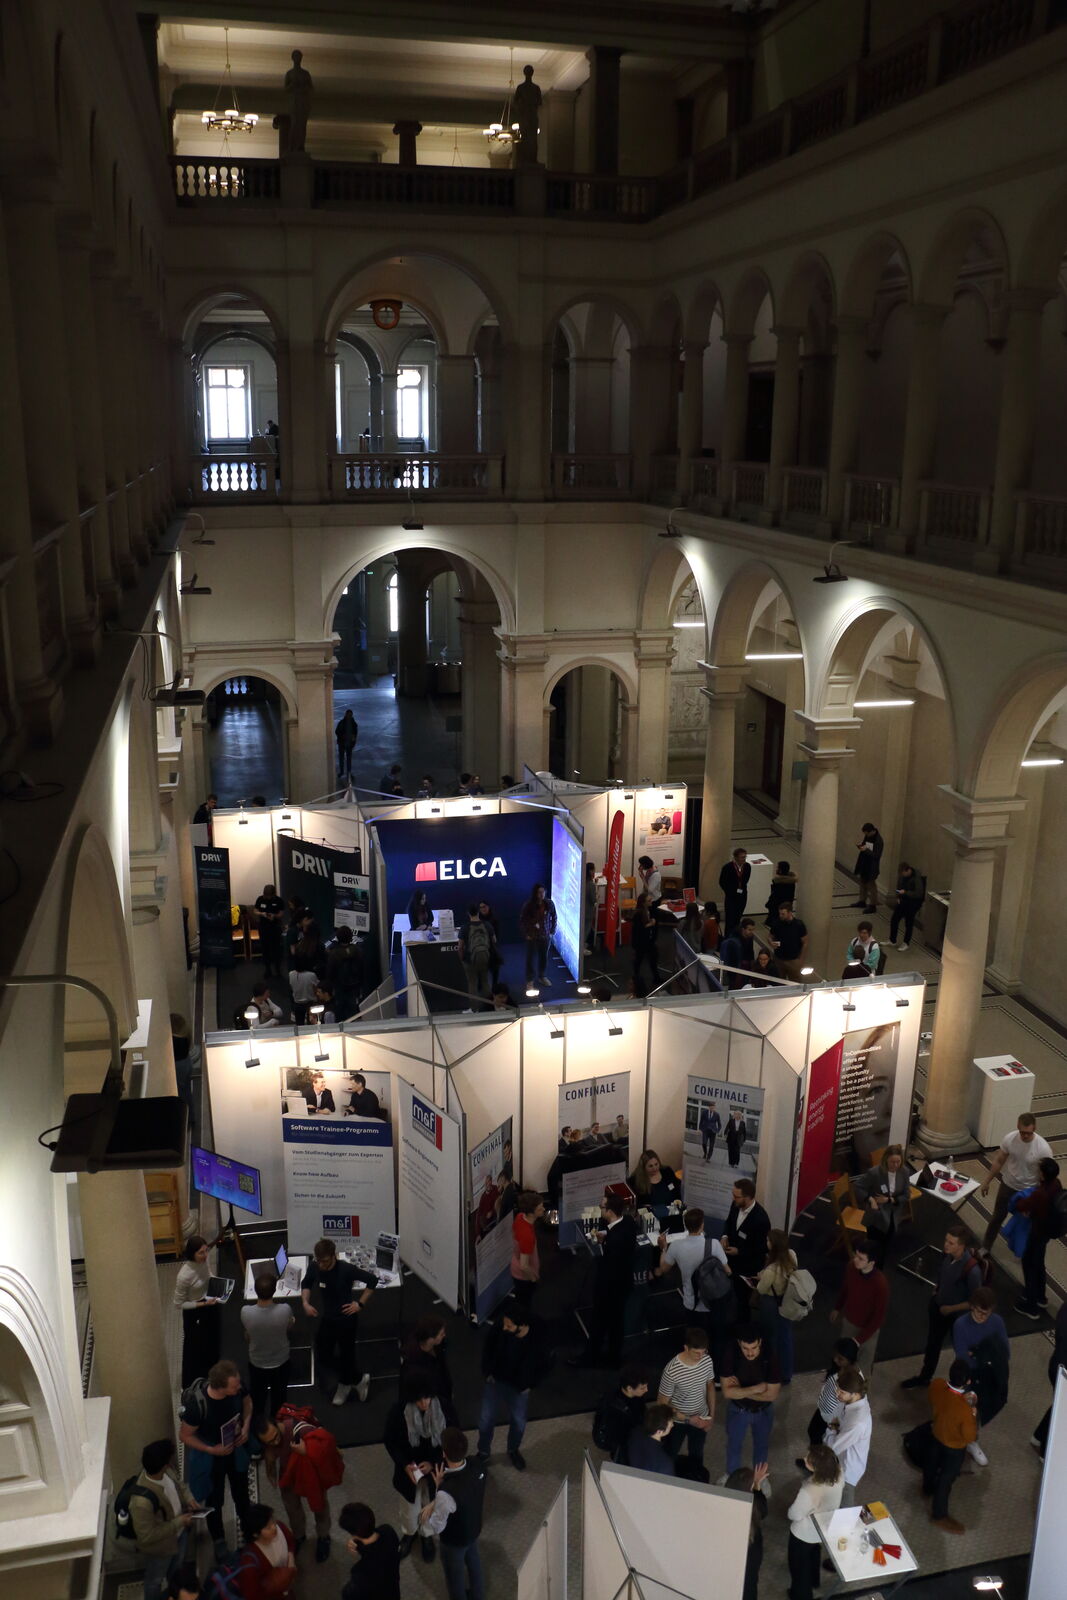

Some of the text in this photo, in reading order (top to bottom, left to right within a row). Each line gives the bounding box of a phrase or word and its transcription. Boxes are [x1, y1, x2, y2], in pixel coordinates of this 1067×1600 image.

[439, 856, 508, 881] ELCA
[841, 1069, 870, 1081] opportunity
[858, 1075, 868, 1084] part
[565, 1082, 616, 1101] CONFINALE
[694, 1084, 748, 1104] CONFINALE
[847, 1083, 872, 1093] extremely
[413, 1104, 435, 1130] m&f
[290, 1123, 319, 1132] Software
[320, 1124, 380, 1136] Trainee-Programm
[472, 1133, 505, 1169] CONFINALE
[324, 1216, 351, 1228] m&f
